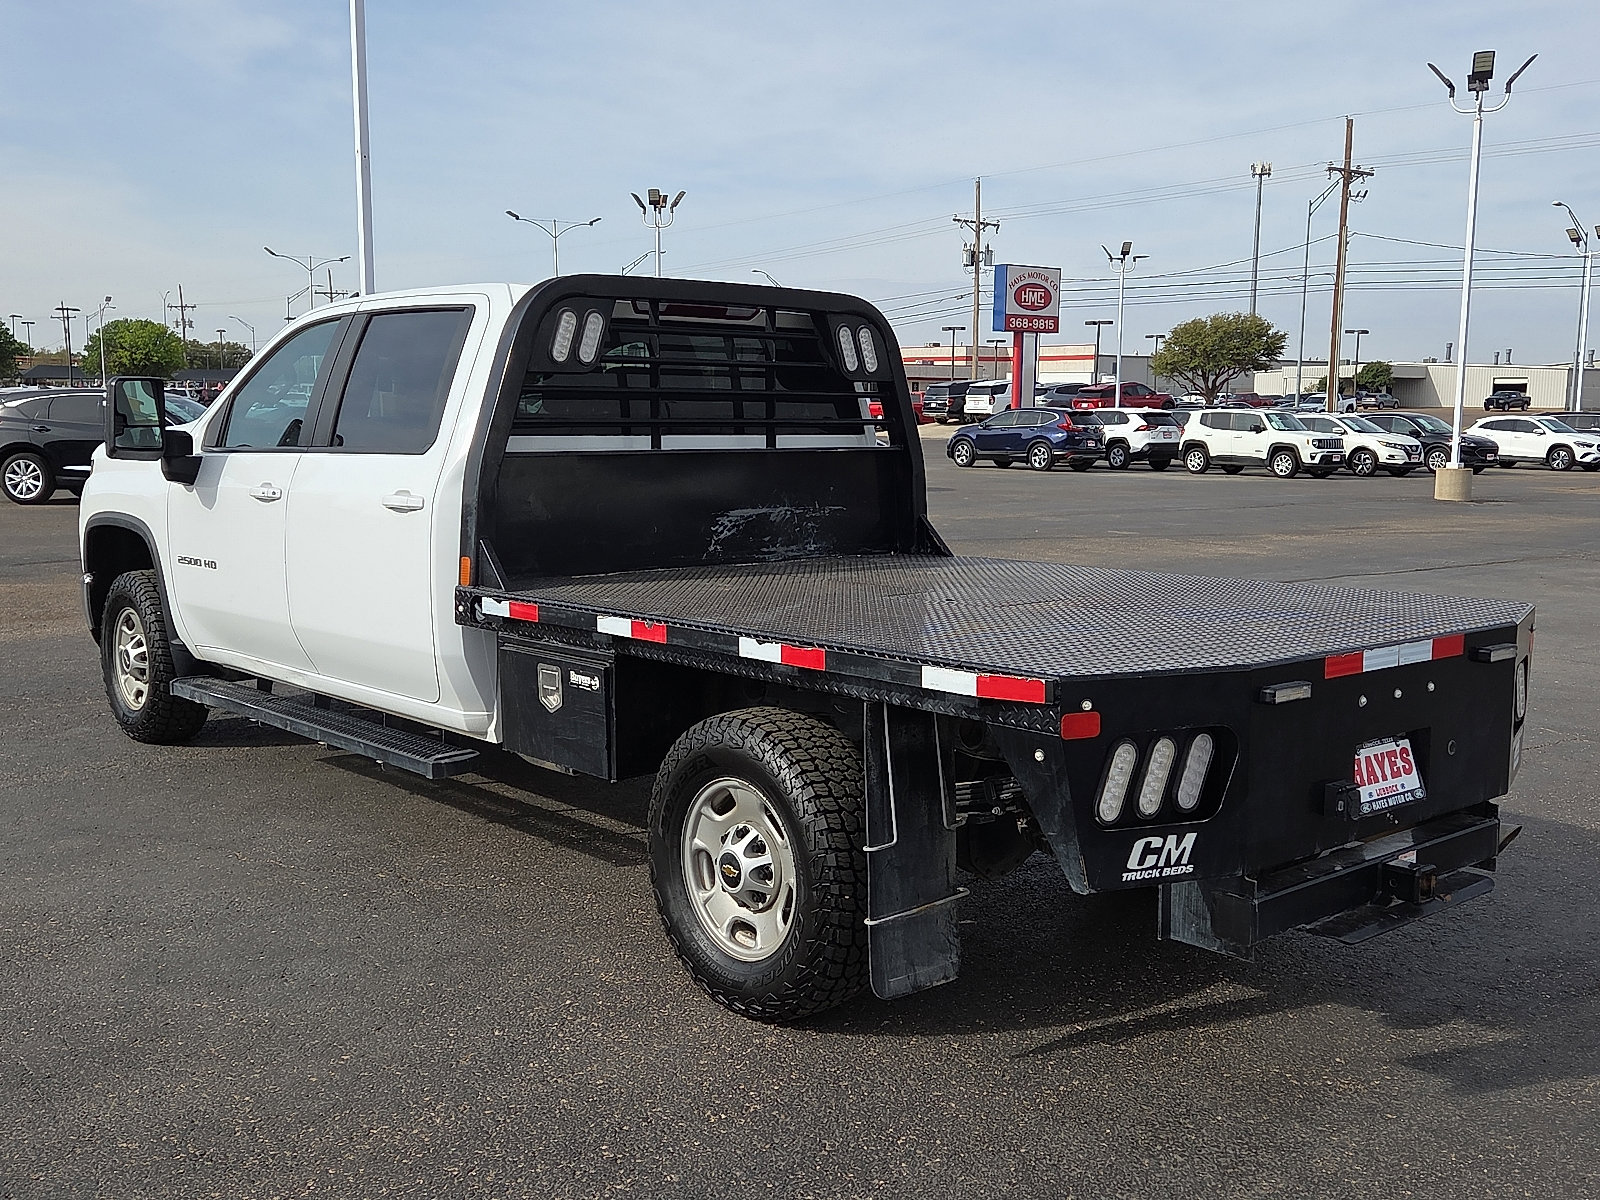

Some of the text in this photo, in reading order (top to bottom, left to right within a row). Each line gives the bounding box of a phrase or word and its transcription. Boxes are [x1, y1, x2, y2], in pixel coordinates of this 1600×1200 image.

[1008, 273, 1027, 290] HAYES
[1027, 271, 1050, 284] MOTOR
[1021, 288, 1045, 306] HMC
[1009, 317, 1055, 330] 368-9815
[177, 555, 217, 570] 2500 HD
[1375, 783, 1399, 797] LUBBOCK
[1372, 799, 1388, 811] HAYES
[1387, 794, 1406, 807] MOTOR
[1126, 832, 1198, 870] CM
[1122, 864, 1195, 882] TRUCK BEDS
